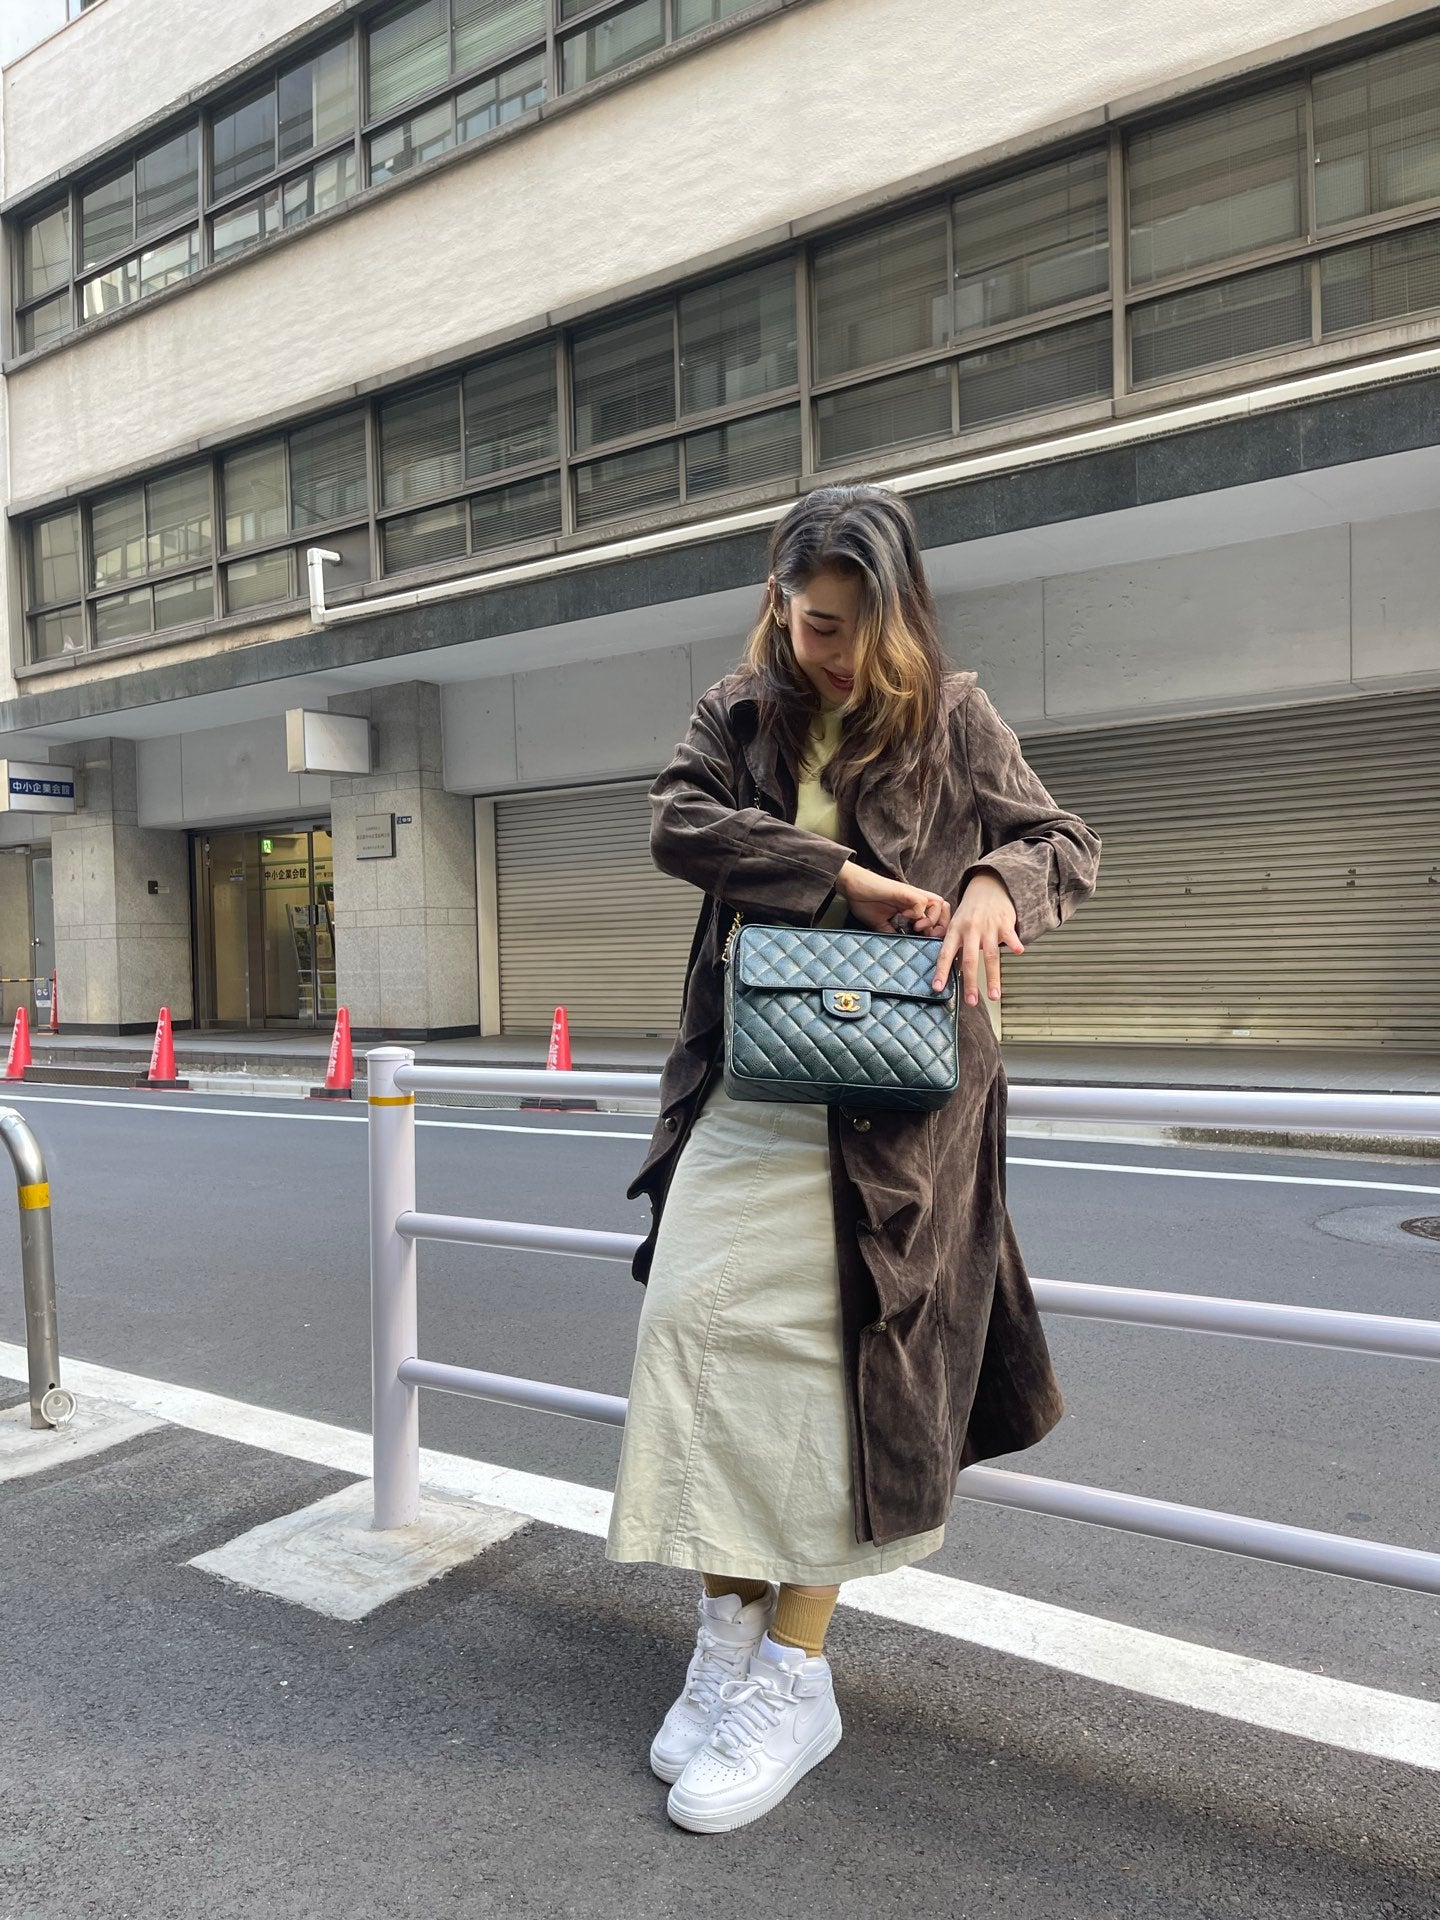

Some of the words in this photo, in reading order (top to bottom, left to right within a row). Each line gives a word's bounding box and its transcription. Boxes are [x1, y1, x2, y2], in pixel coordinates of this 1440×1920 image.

[12, 781, 70, 795] 中小企業会館
[264, 868, 307, 880] 中小企業会館
